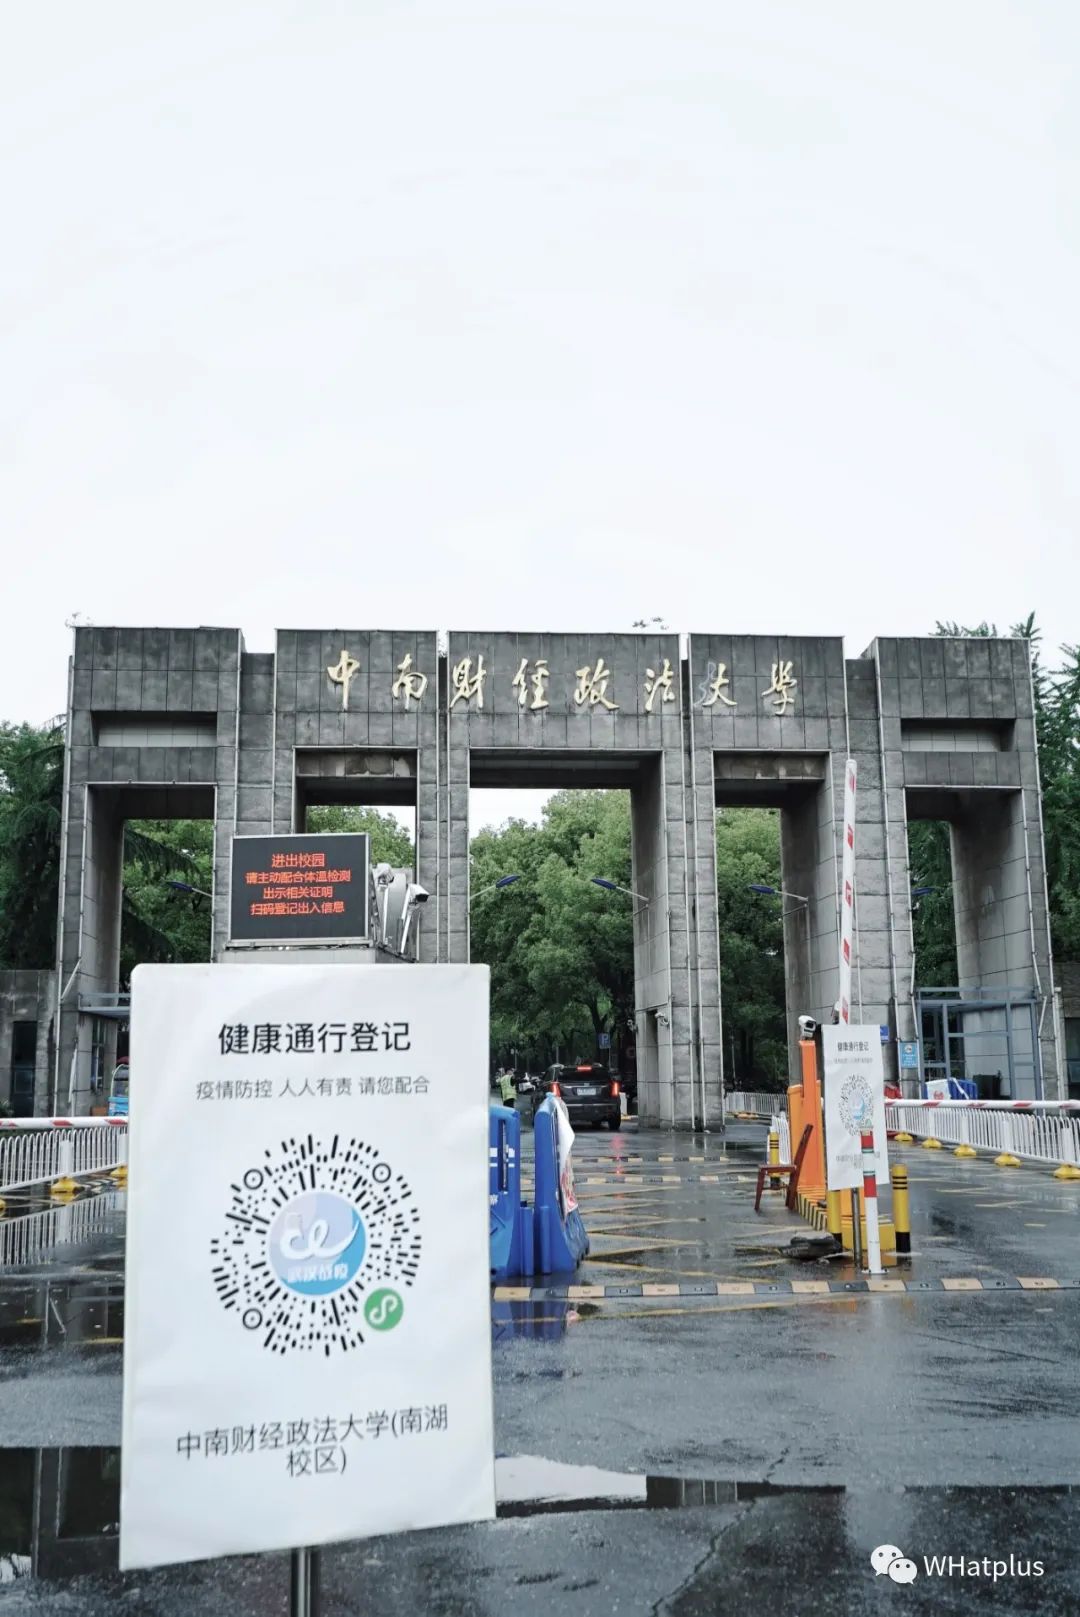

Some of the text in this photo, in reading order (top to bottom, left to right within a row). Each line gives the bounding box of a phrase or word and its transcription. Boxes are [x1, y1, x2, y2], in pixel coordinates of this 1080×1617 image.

[272, 853, 325, 868] 进出校园
[245, 870, 351, 884] 请主动配合体温检测
[263, 886, 333, 899] 出示相关证明
[250, 901, 345, 916] 扫码登记出入信息
[218, 1022, 411, 1055] 健康通行登记
[196, 1075, 431, 1101] 疫情防控 人人有责 请您配合
[177, 1403, 448, 1461] 中南财经政法大学(南湖
[286, 1445, 347, 1478] 校区)
